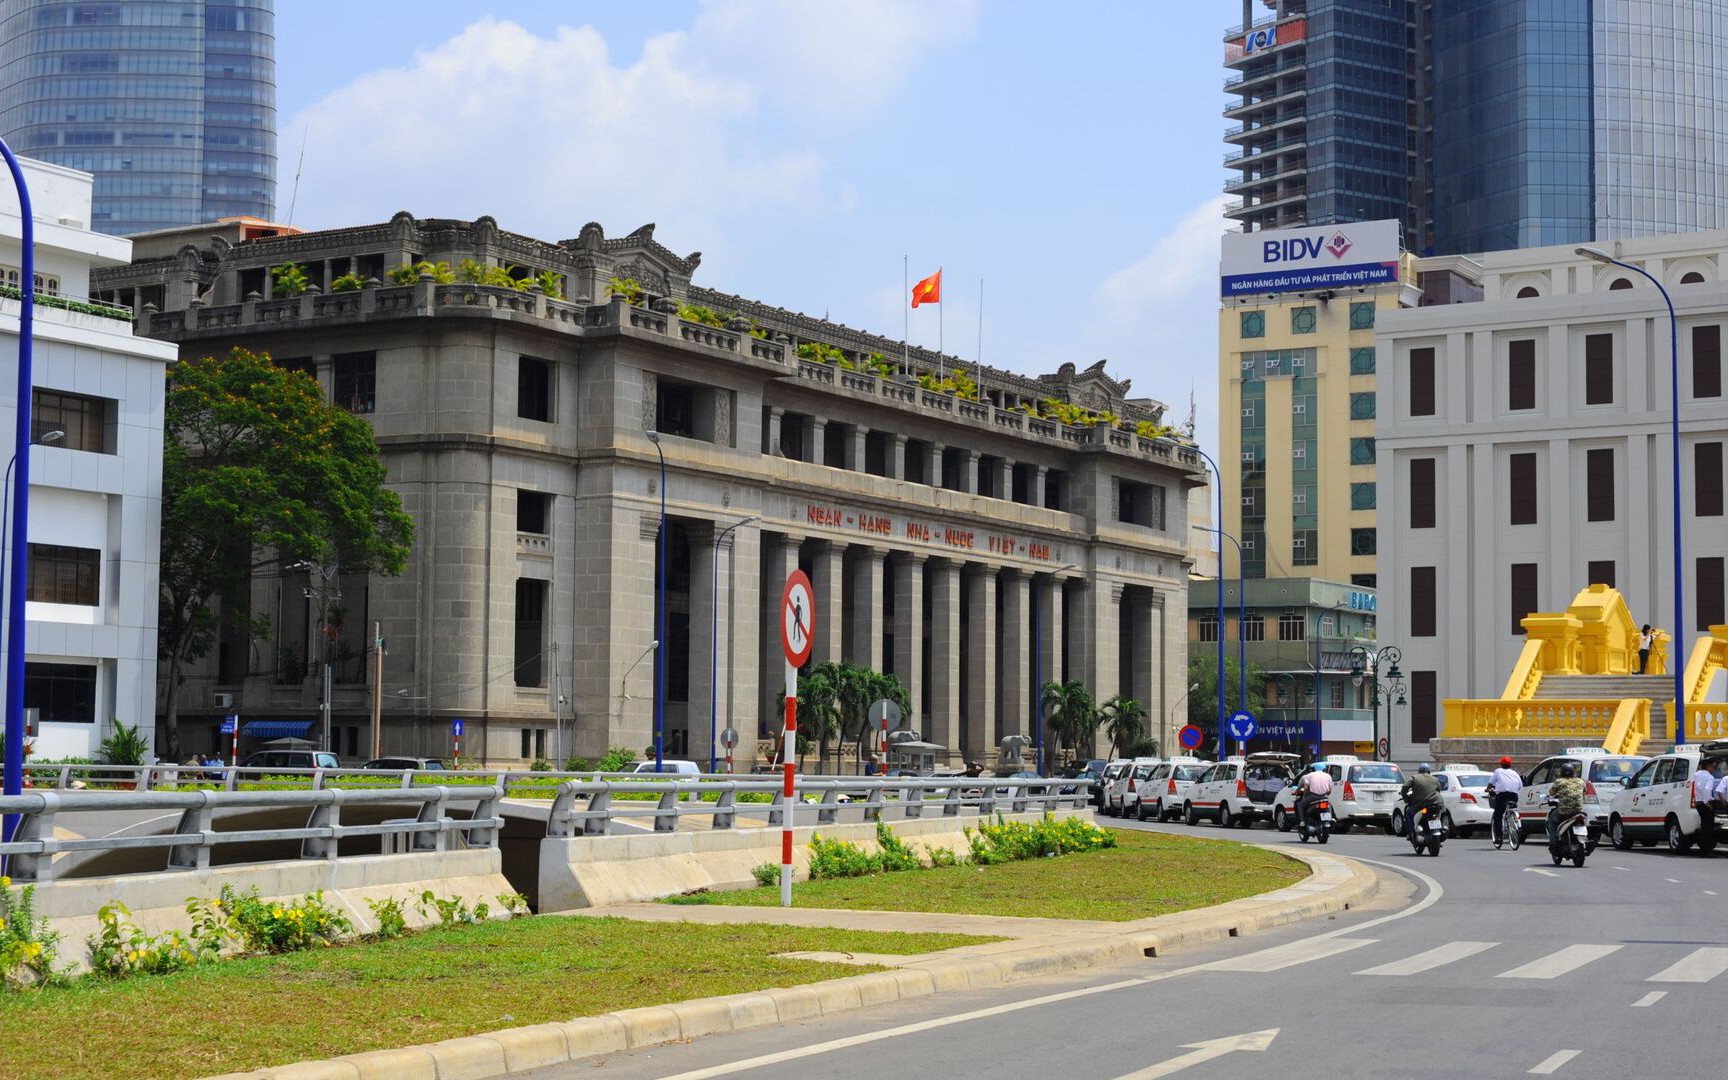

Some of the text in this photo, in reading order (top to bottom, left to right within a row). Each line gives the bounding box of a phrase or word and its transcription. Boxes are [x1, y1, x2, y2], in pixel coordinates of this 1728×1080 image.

[1263, 236, 1324, 263] BIDV
[1253, 278, 1274, 288] HÀNG
[1312, 273, 1331, 283] PHÁT
[1352, 270, 1368, 281] VIỆT
[1369, 269, 1387, 278] NAM
